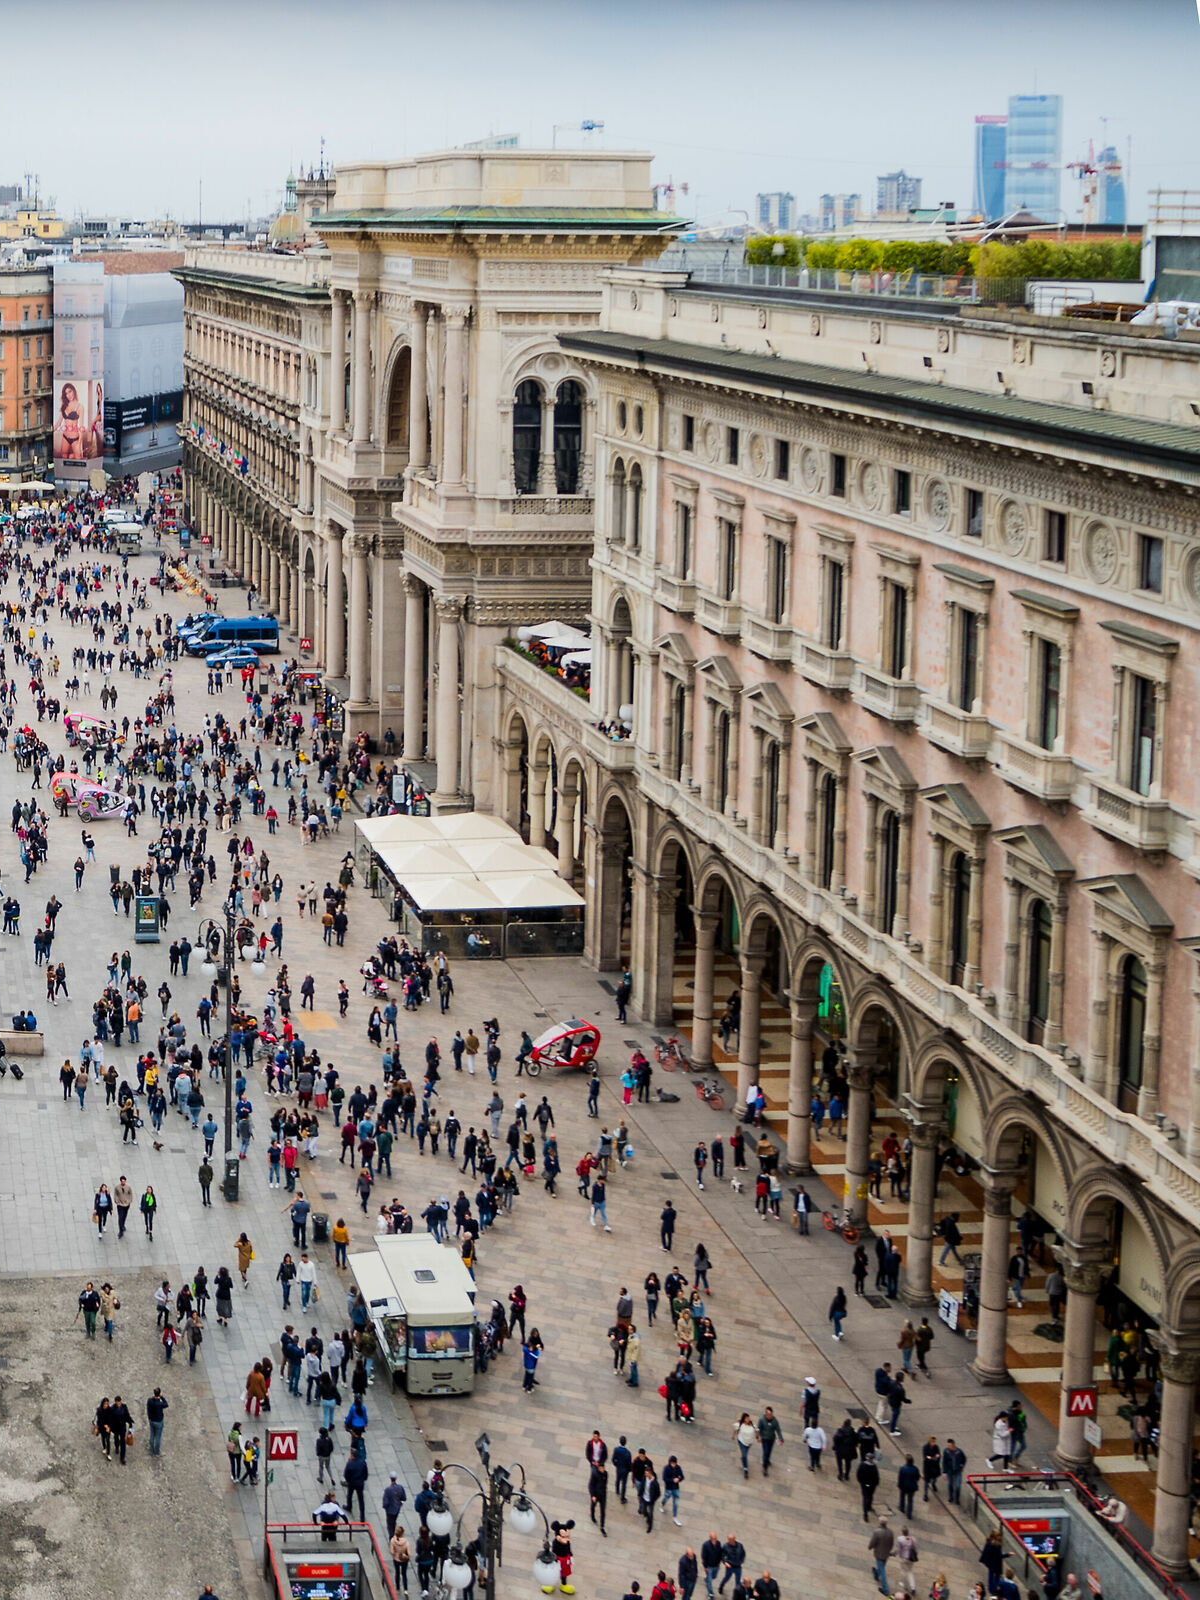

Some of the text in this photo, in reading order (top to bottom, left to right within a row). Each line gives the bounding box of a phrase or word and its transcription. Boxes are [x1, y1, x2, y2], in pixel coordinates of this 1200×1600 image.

[301, 640, 311, 648] M
[1071, 1395, 1093, 1411] M
[271, 1435, 296, 1454] M
